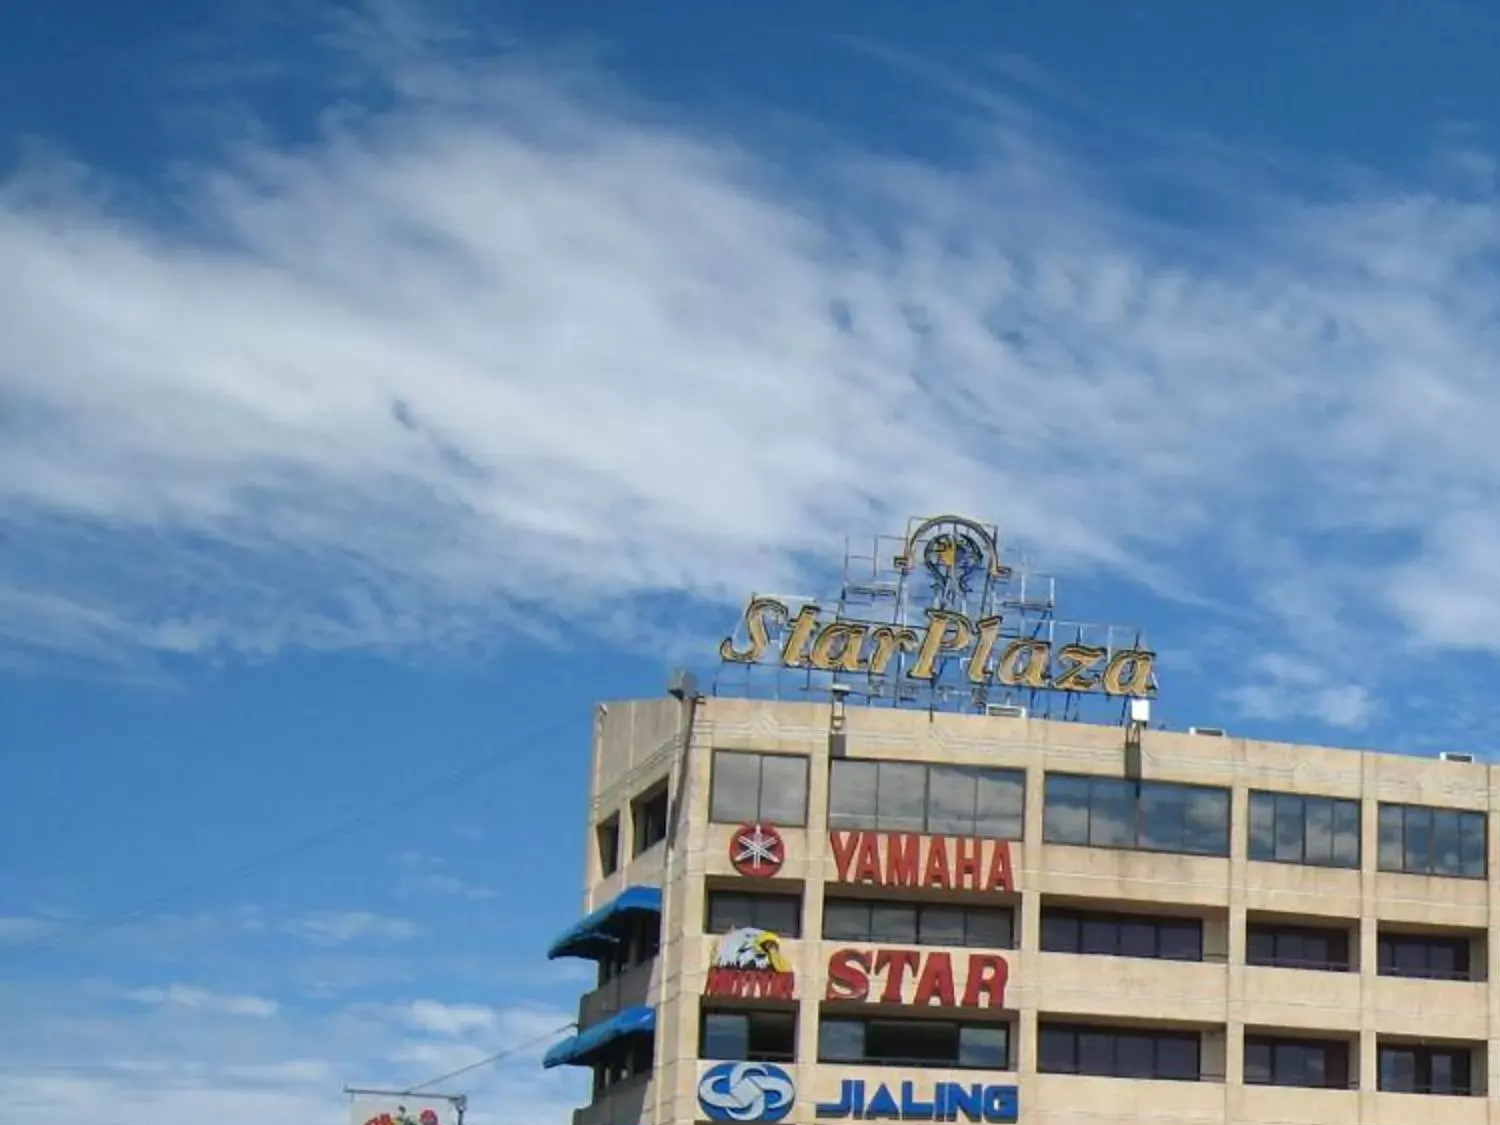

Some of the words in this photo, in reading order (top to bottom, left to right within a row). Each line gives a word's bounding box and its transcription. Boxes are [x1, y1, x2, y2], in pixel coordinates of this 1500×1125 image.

[829, 830, 1014, 892] YAMAHA
[825, 948, 1009, 1007] STAR
[815, 1078, 1019, 1123] JIALING
